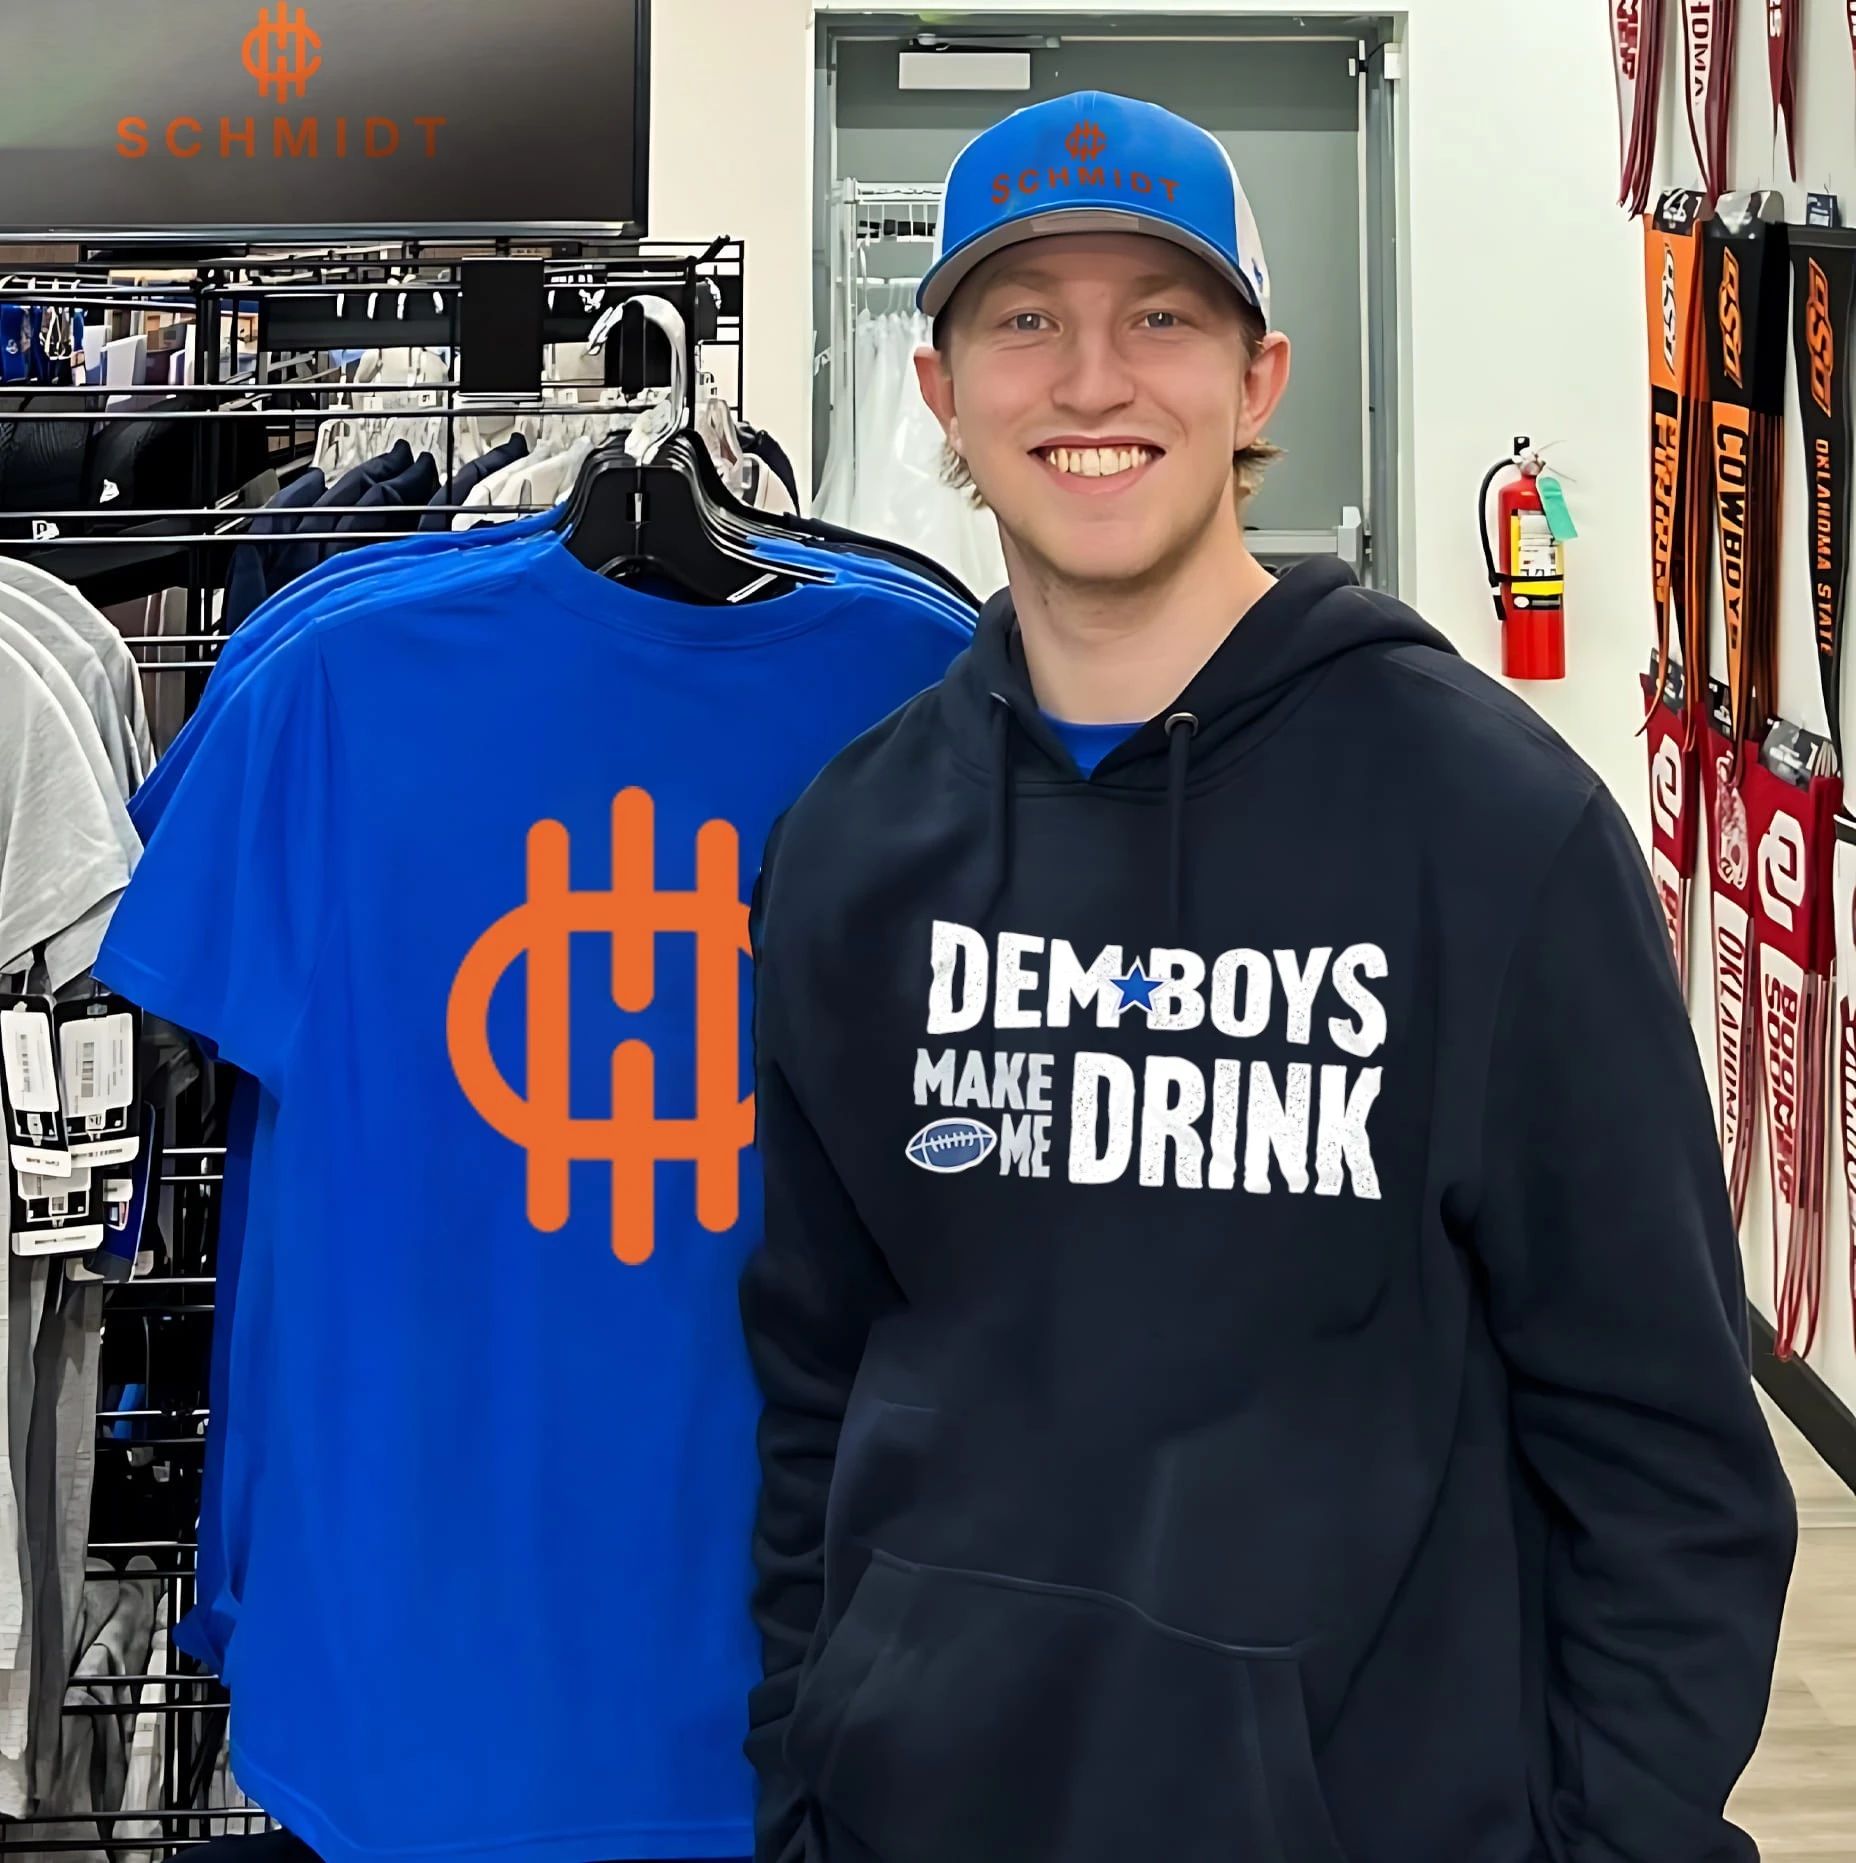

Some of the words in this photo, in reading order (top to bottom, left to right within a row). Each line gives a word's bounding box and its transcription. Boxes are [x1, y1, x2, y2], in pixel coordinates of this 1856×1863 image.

[115, 115, 448, 159] SCHMIDT
[991, 165, 1181, 204] SCHMIDT
[1816, 438, 1832, 570] OKLAHOMA
[1816, 582, 1834, 656] STATE
[926, 919, 1123, 1035] DEM
[1146, 942, 1390, 1057] BOYS
[1718, 926, 1744, 1144] OKLAHOMA
[913, 1047, 1055, 1111] MAKE
[999, 1113, 1052, 1178] ME
[1067, 1051, 1384, 1200] DRINK
